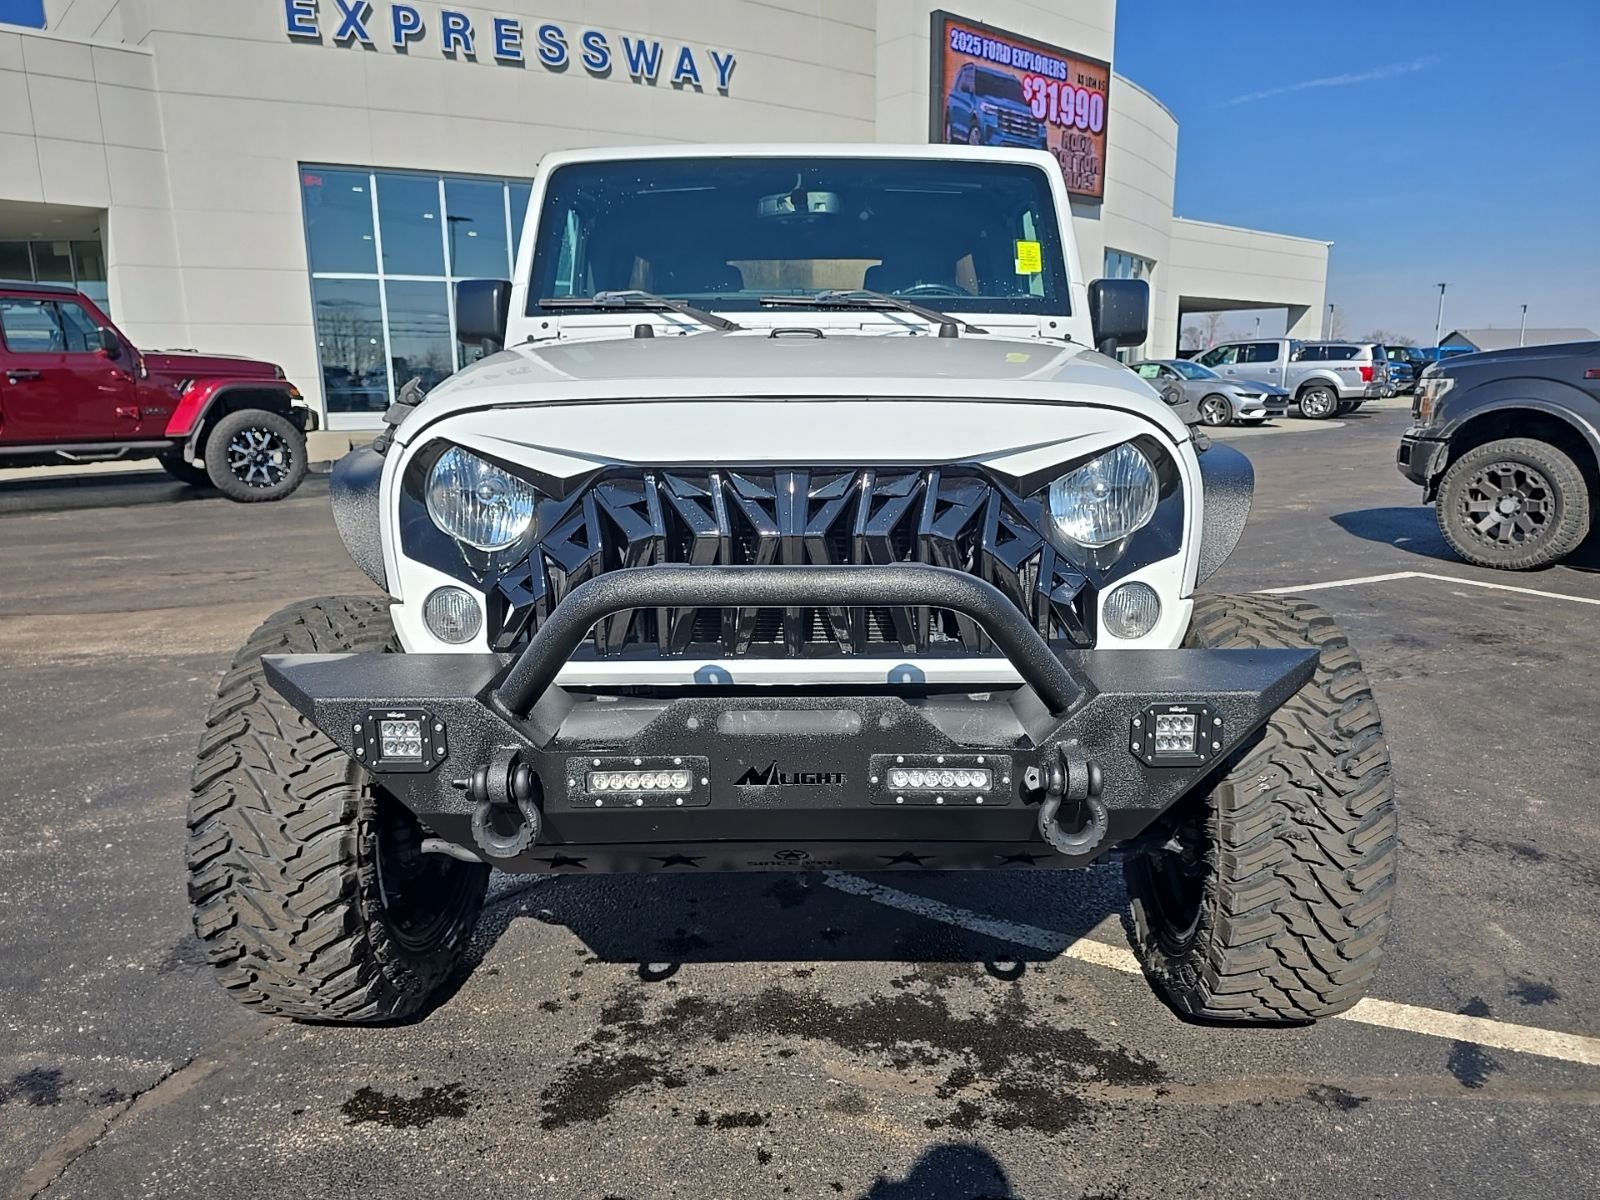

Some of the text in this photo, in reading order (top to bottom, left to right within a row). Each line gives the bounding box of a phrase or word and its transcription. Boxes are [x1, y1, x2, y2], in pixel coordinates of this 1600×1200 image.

[283, 0, 737, 90] EXPRESSWAY
[951, 29, 1066, 80] 2025 FORD EXPLORERS
[1023, 76, 1104, 133] $31,990
